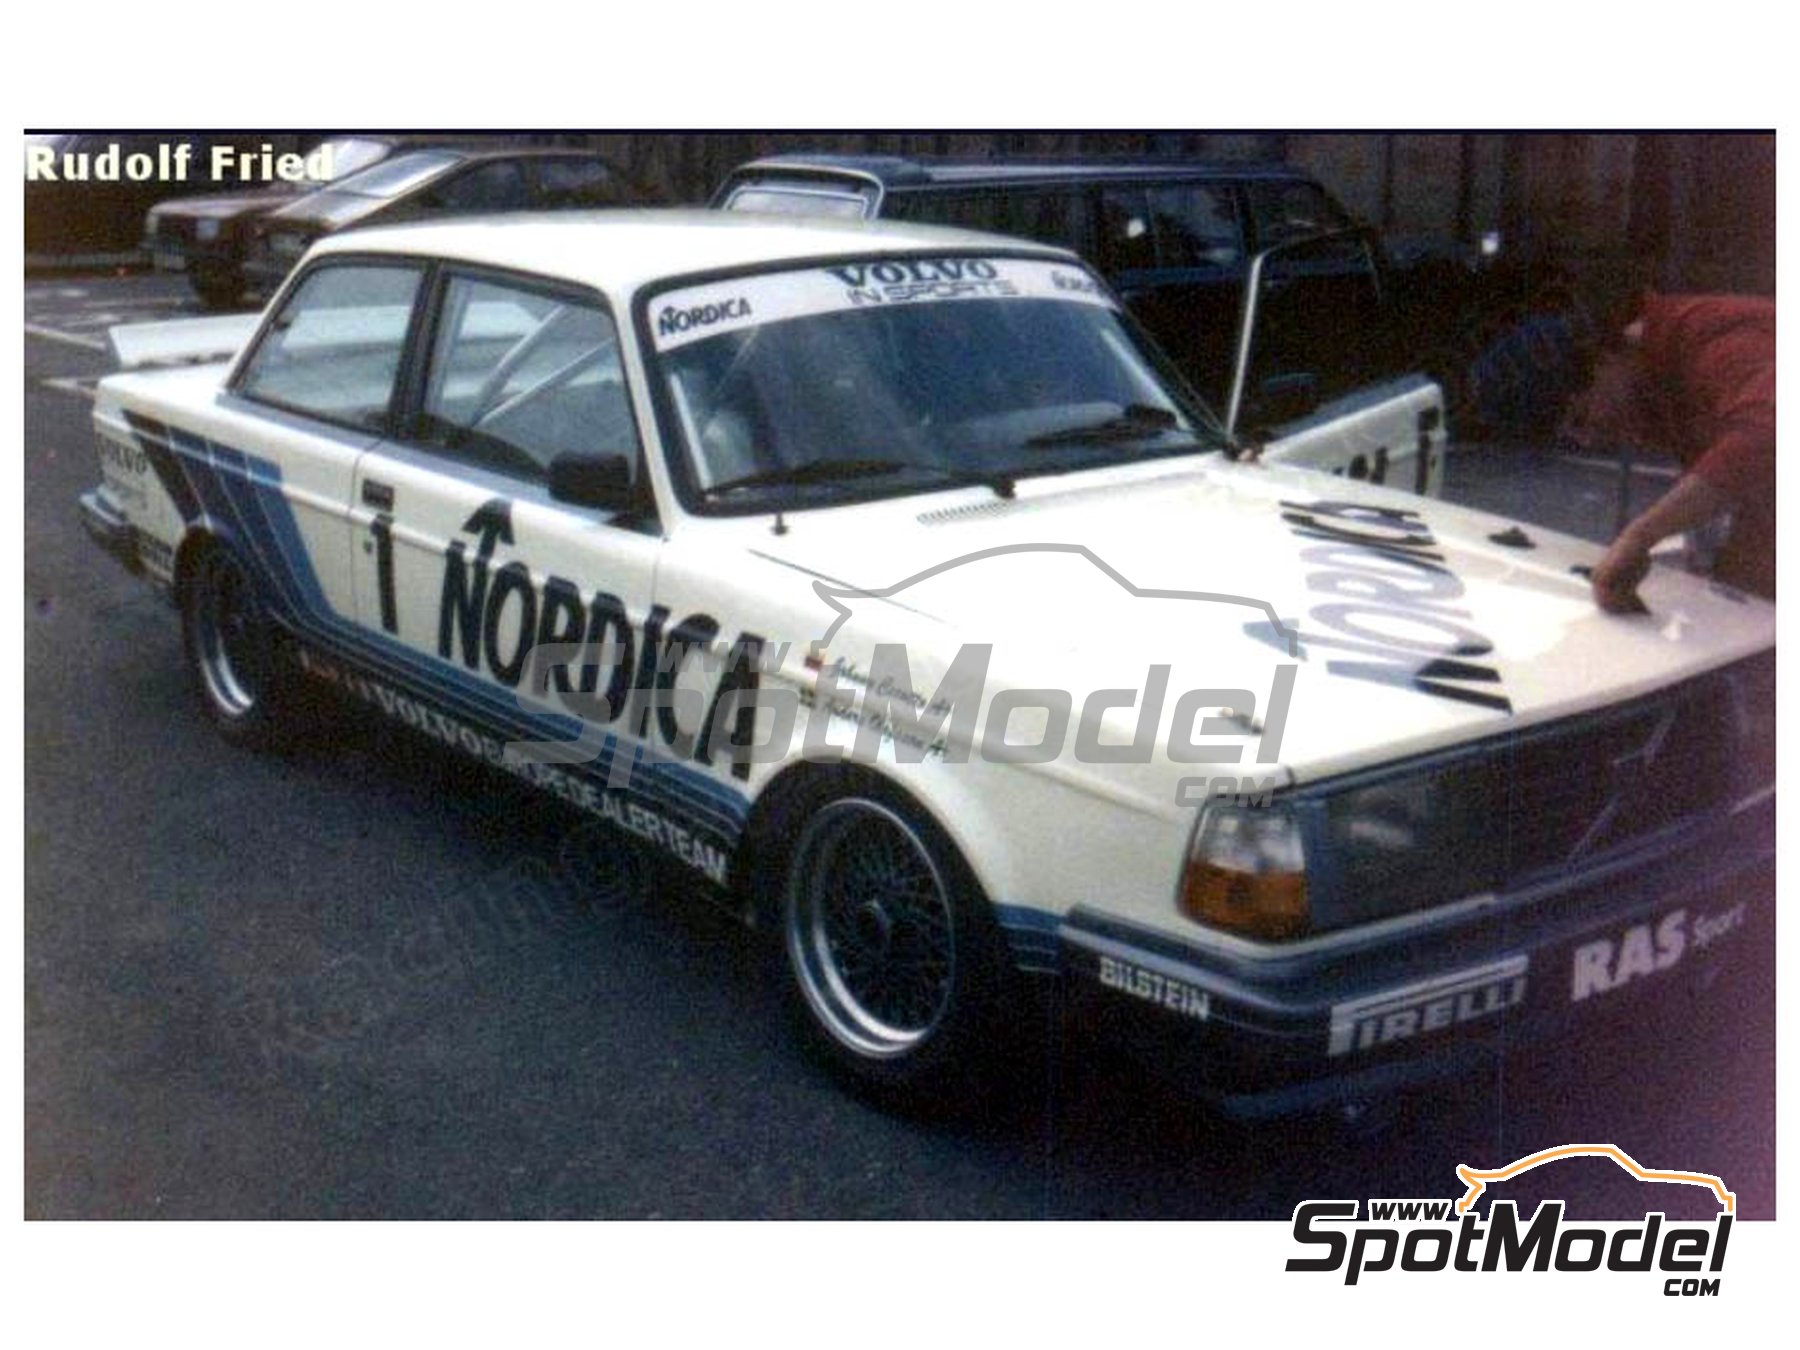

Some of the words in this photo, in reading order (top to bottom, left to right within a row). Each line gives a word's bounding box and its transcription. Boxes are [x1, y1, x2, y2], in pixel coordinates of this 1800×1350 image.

[659, 297, 753, 336] NORDICA
[826, 260, 997, 287] VOLVO
[368, 513, 398, 634] 1
[1278, 500, 1513, 716] NORDICA
[437, 538, 767, 782] NORDICA
[1099, 955, 1212, 1021] BILSTEIN
[1572, 909, 1687, 1002] RAS
[1693, 903, 1746, 947] Sport
[1328, 956, 1529, 1057] PIRELLI
